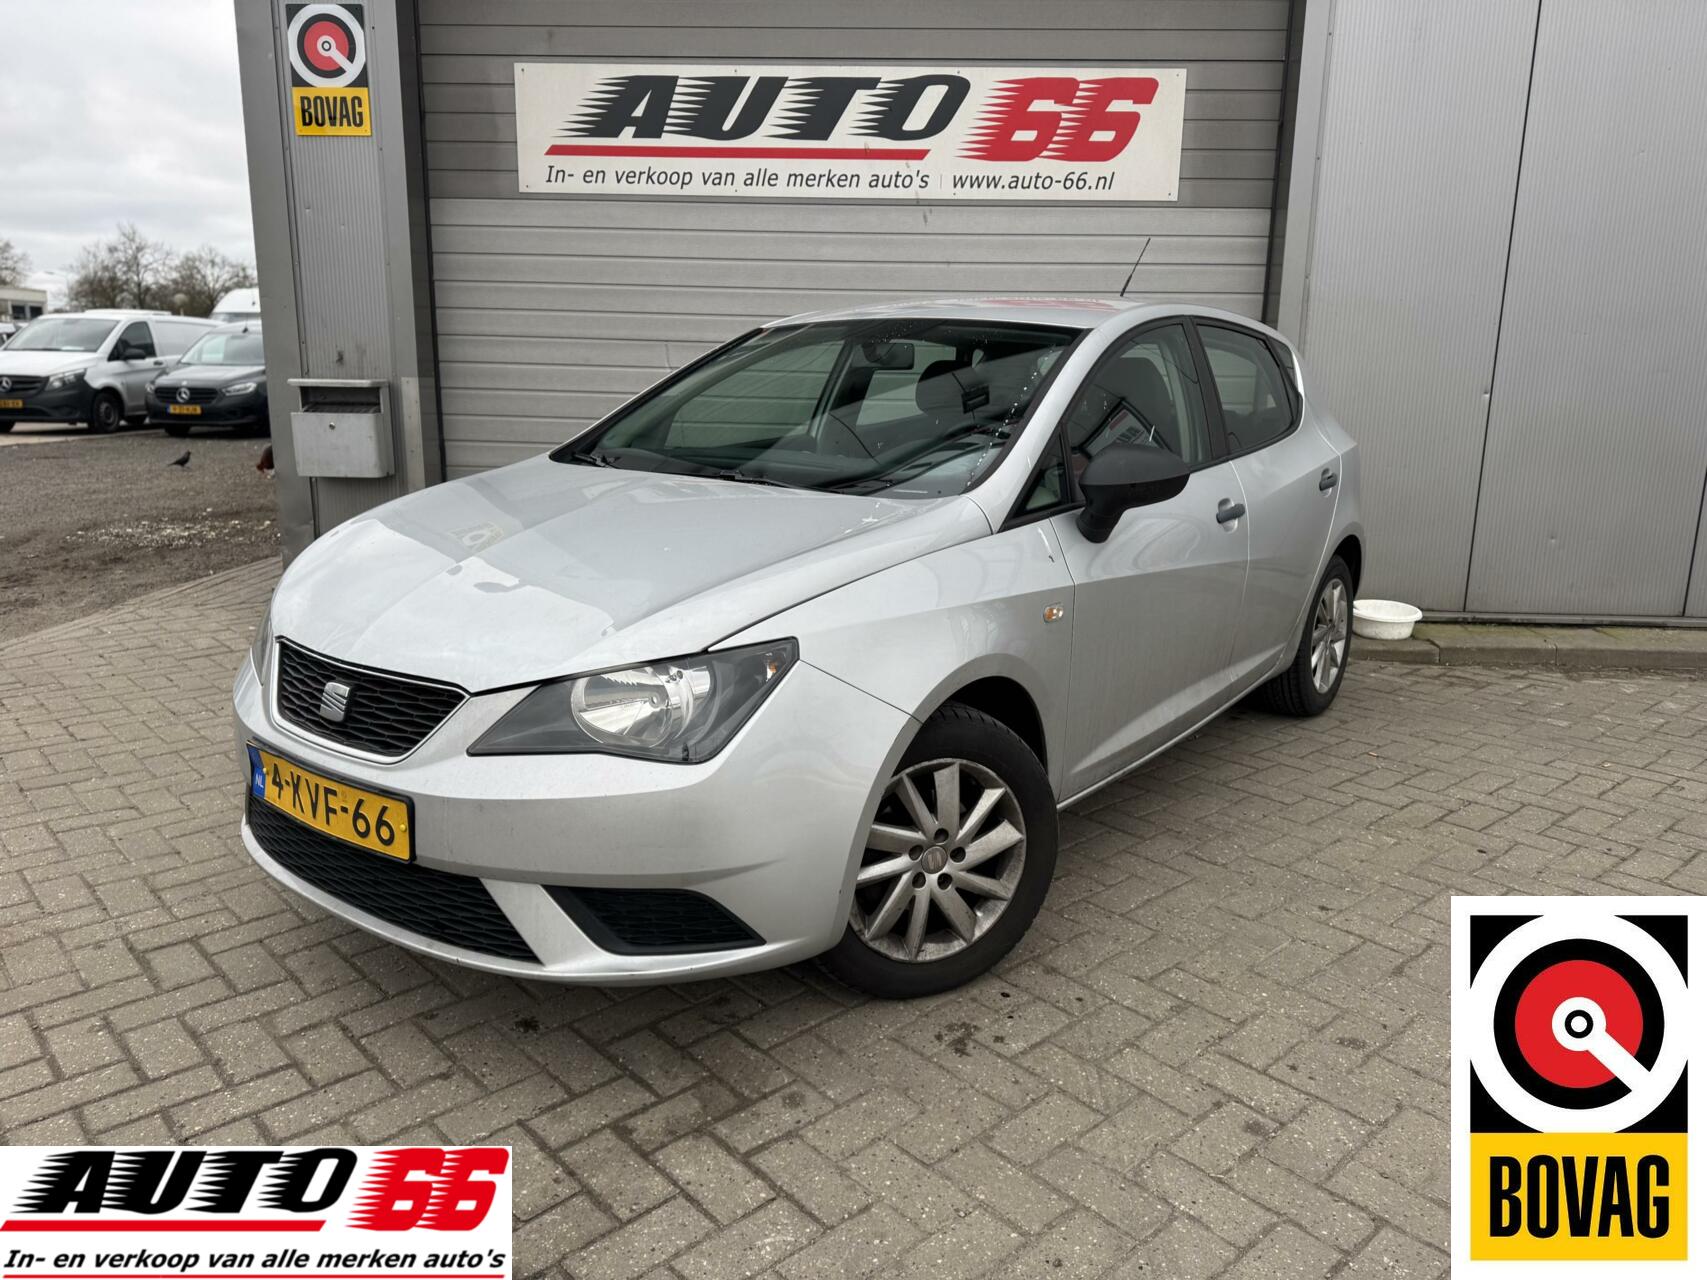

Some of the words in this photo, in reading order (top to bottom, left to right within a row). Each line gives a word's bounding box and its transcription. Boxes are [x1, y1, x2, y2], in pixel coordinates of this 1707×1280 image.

[300, 95, 364, 127] BOVAG
[551, 74, 971, 141] AUTO
[955, 77, 1159, 162] 66
[546, 165, 574, 183] In-
[583, 169, 606, 184] en
[615, 166, 693, 189] verkoop
[702, 171, 735, 186] van
[743, 168, 778, 187] alle
[786, 169, 860, 188] merken
[868, 170, 930, 189] auto's
[952, 171, 1115, 191] www.auto-66.nl
[271, 763, 396, 846] 4-KVF-66
